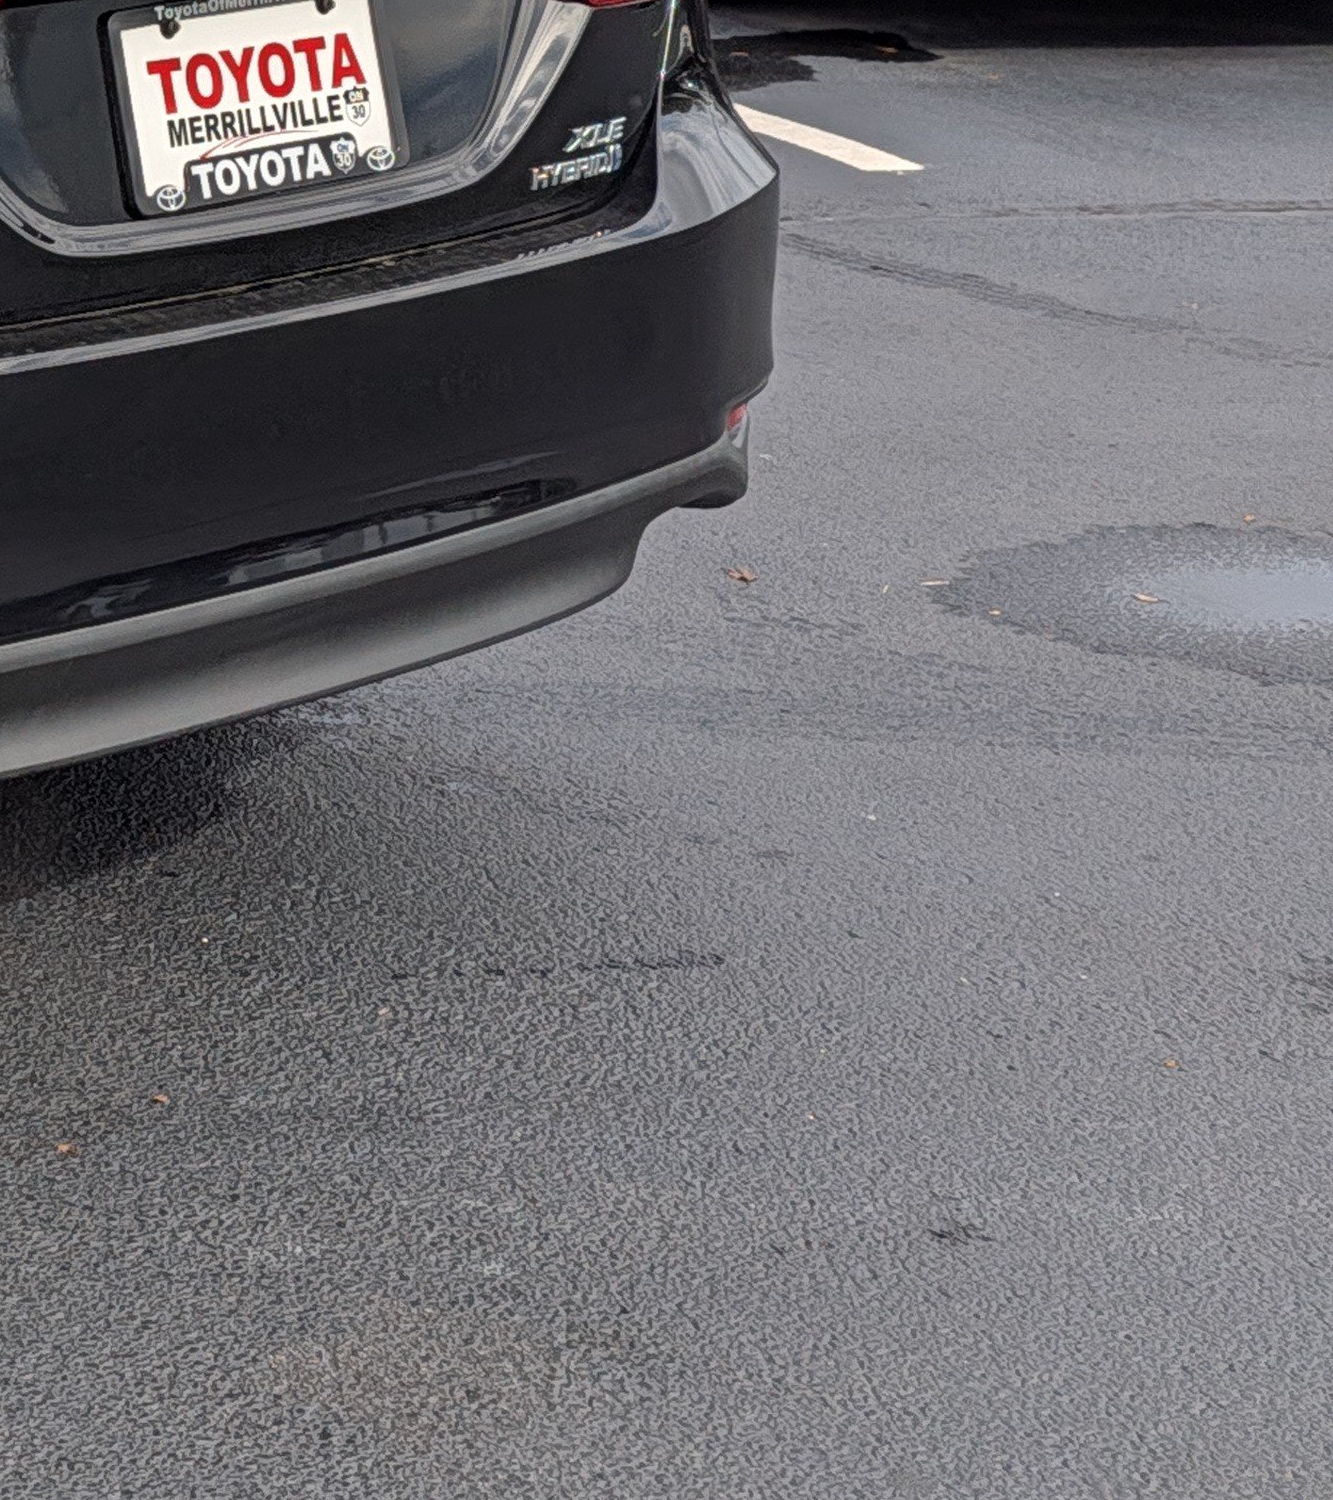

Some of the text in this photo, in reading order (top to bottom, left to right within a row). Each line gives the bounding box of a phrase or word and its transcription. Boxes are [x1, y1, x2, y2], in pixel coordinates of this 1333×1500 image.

[146, 33, 367, 114] TOYOTA
[167, 94, 344, 148] MERRILLVILLE
[351, 103, 366, 119] 30
[562, 117, 627, 153] XLE
[191, 143, 332, 200] TOYOTA
[335, 152, 352, 168] 30
[530, 143, 623, 190] HYBRID
